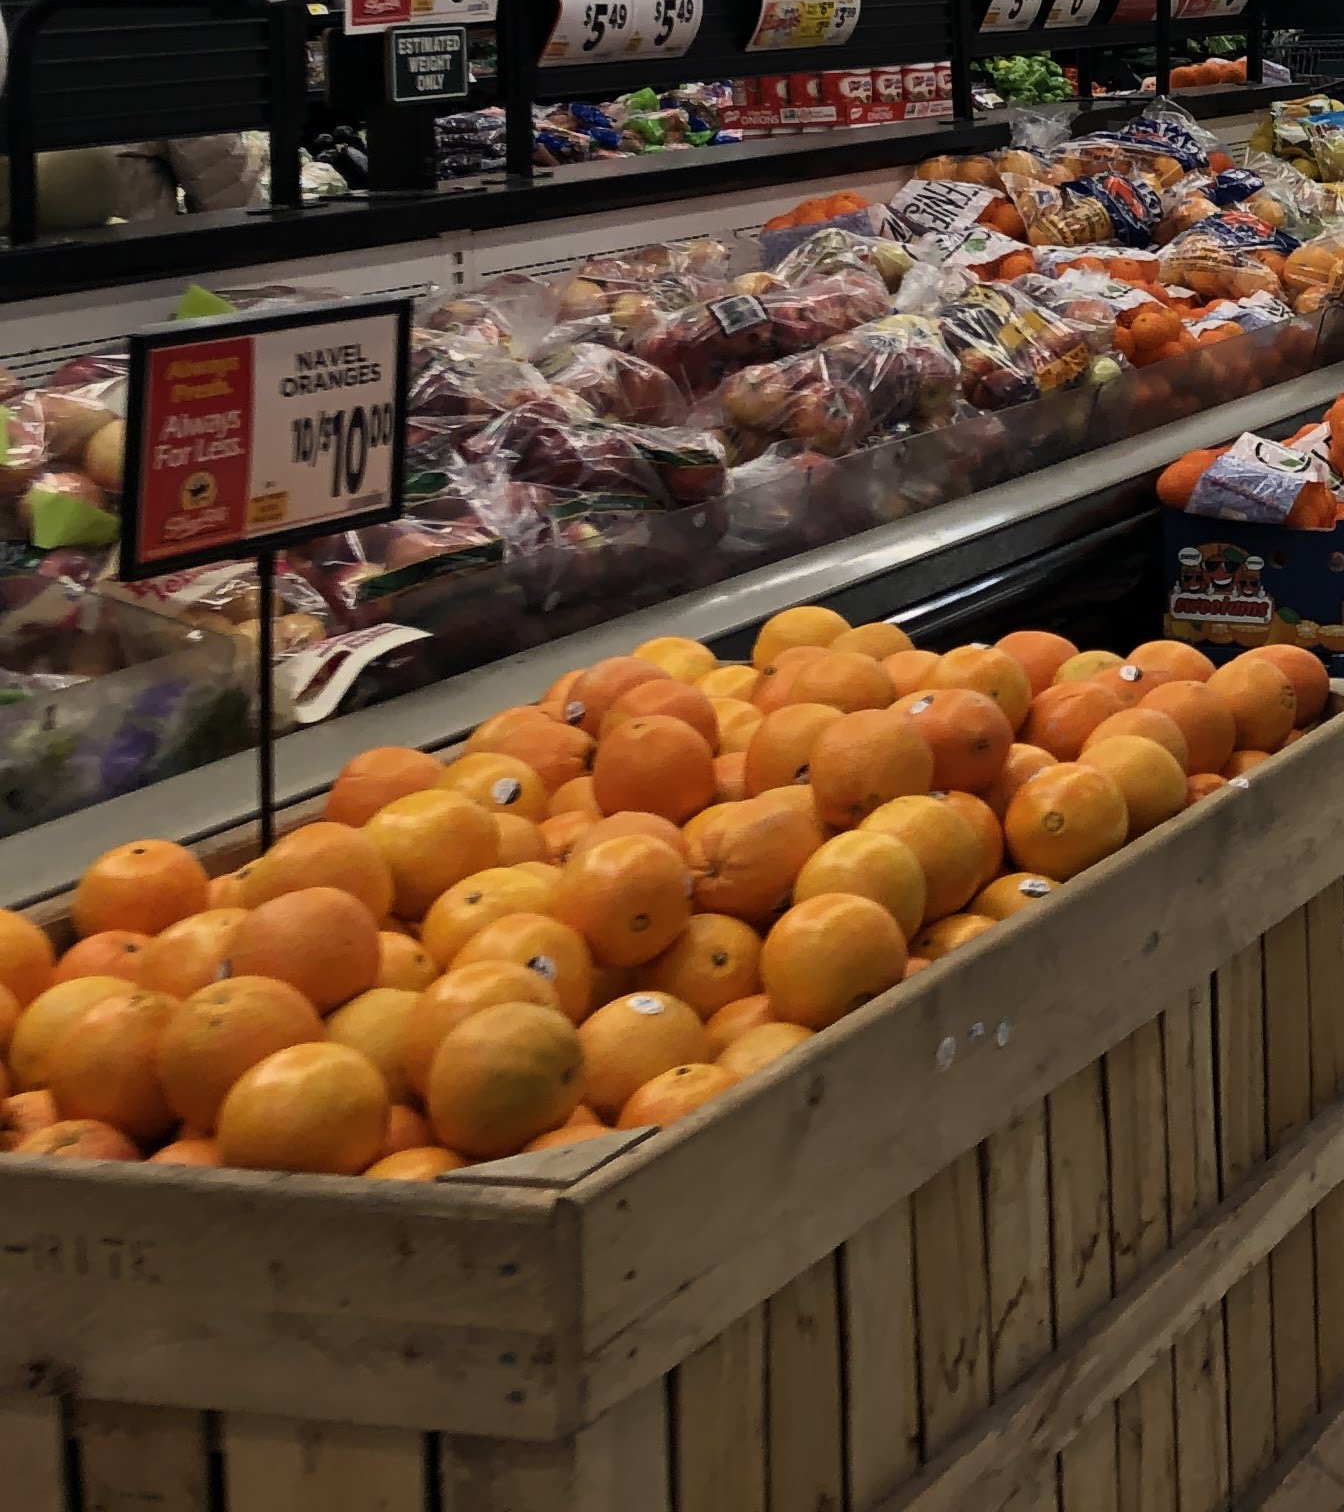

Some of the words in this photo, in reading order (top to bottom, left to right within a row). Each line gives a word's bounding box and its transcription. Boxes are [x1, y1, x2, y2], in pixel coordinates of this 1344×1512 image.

[398, 35, 461, 55] ESTIMATED
[407, 54, 452, 73] WEIGHT
[415, 74, 445, 92] ONLY
[294, 342, 366, 371] NAVEL
[278, 361, 382, 398] ORANGES
[162, 408, 242, 440] Always
[154, 442, 192, 470] For
[1173, 596, 1270, 618] sweetums
